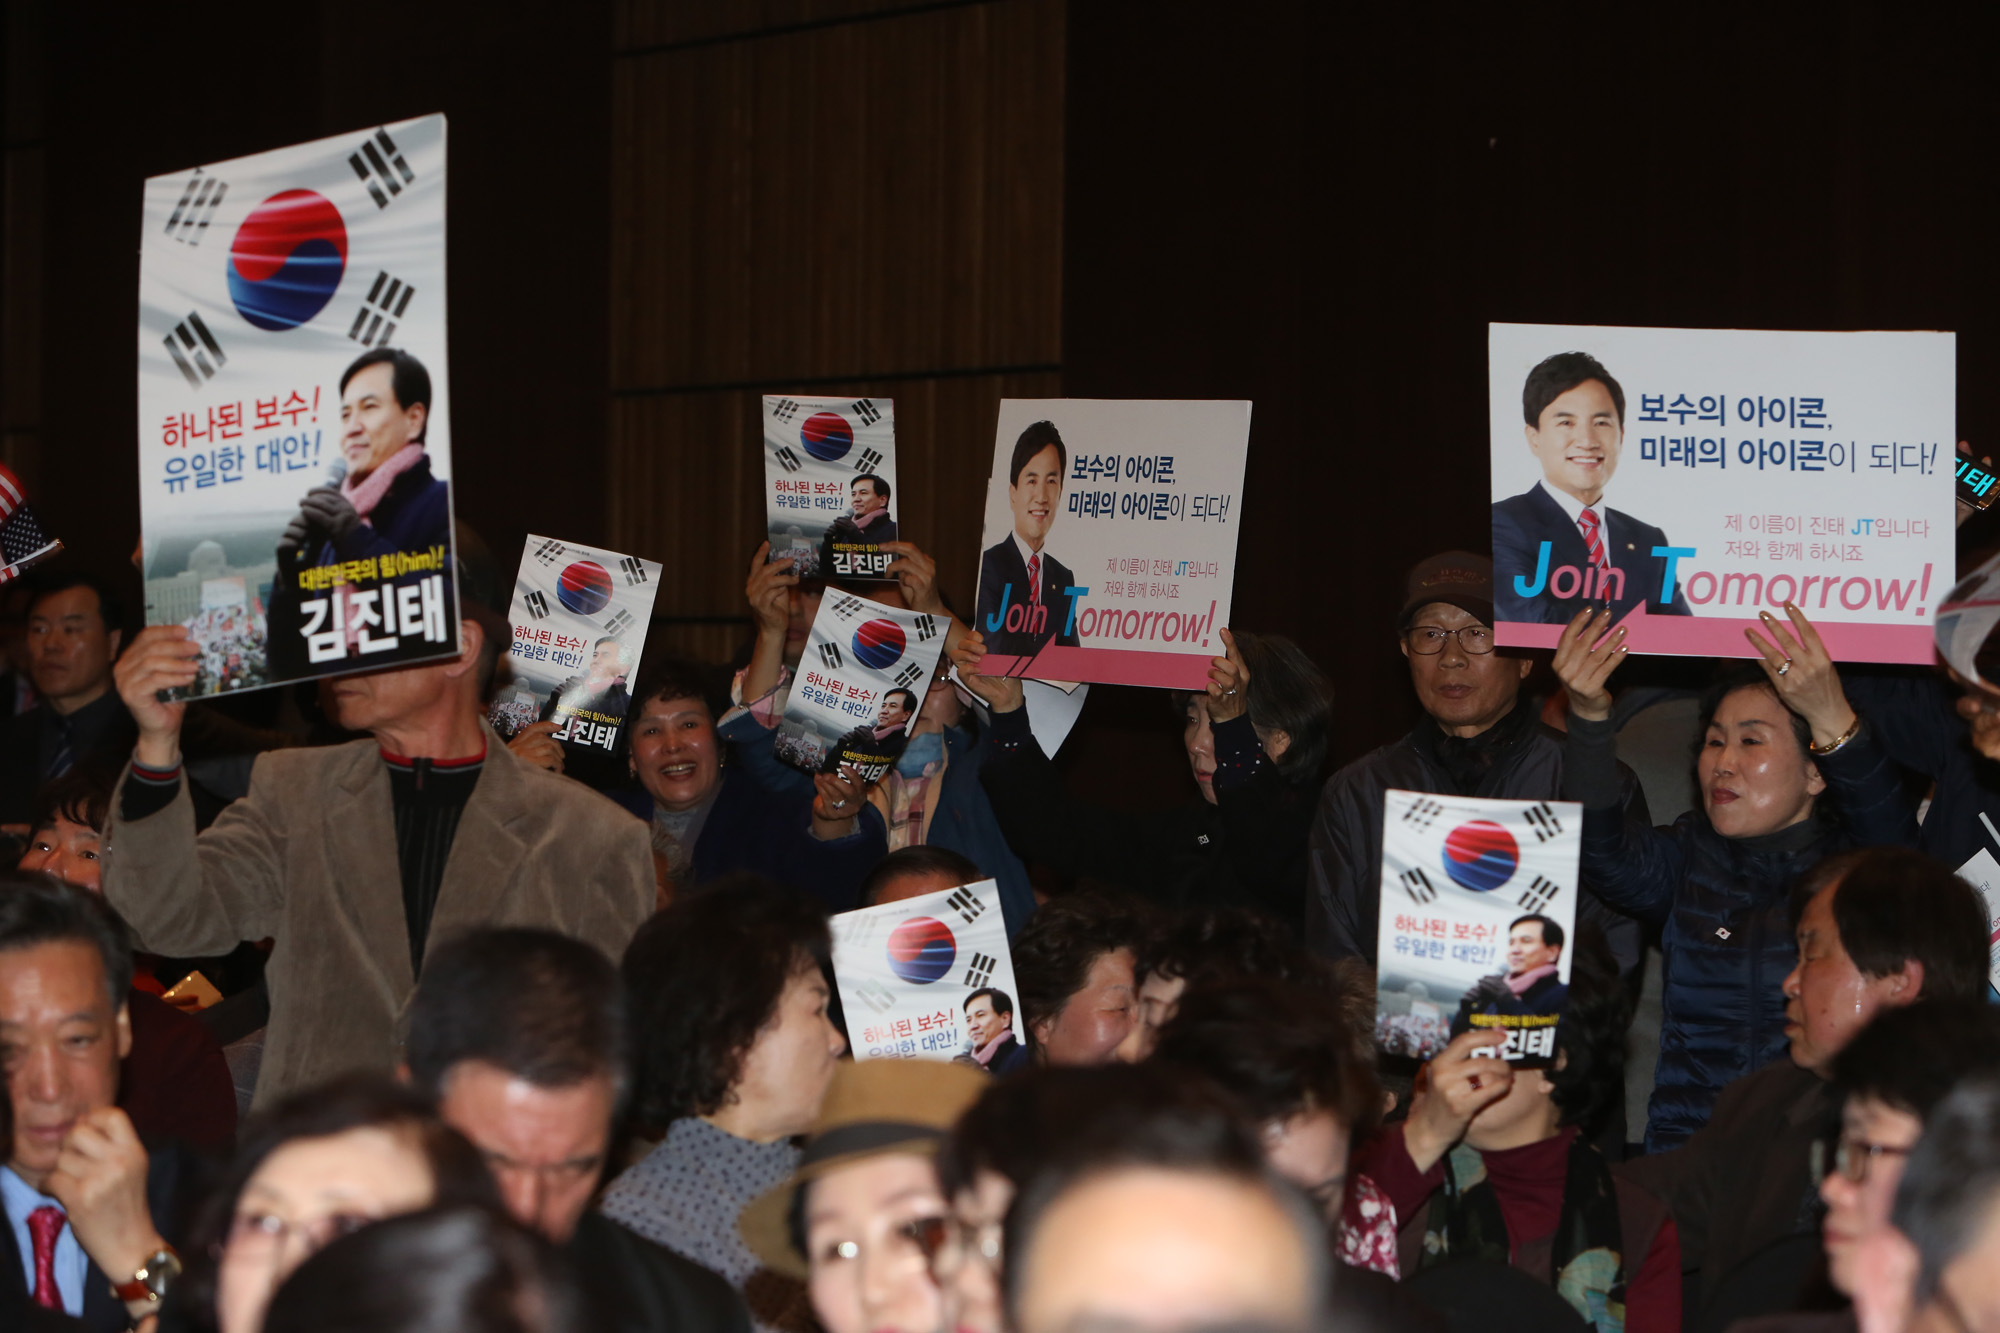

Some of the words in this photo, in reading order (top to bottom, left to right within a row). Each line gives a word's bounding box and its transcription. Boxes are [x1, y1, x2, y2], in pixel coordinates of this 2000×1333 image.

[162, 401, 243, 448] 하나된
[253, 385, 321, 431] 보수!
[1638, 393, 1727, 428] 보수의
[1737, 396, 1834, 431] 아이콘,
[163, 445, 246, 494] 유일한
[256, 429, 322, 474] 대안!
[1071, 454, 1121, 483] 보수의
[1125, 455, 1176, 485] 아이콘,
[1640, 435, 1727, 469] 미래의
[1738, 438, 1857, 473] 아이콘이
[1868, 441, 1938, 476] 되다!
[775, 480, 810, 494] 하나된
[813, 482, 843, 495] 보수!
[776, 494, 811, 509] 유일한
[815, 497, 844, 510] 대안!
[1068, 491, 1117, 519] 미래의
[1120, 492, 1186, 522] 아이콘이
[1191, 493, 1231, 523] 되다!
[1724, 514, 1743, 534] 제
[1749, 514, 1803, 536] 이름이
[1809, 516, 1846, 538] 진태
[1851, 518, 1930, 539] JT입니다
[1724, 539, 1762, 560] 저와
[1766, 541, 1805, 562] 함께
[1809, 541, 1865, 564] 하시죠
[299, 557, 378, 591] 대한민국의
[379, 545, 445, 578] 힘(him)!
[1106, 557, 1118, 573] 제
[1120, 558, 1149, 574] 이름이
[1152, 559, 1172, 576] 진태
[1174, 560, 1219, 579] JT입니다
[1512, 540, 1626, 601] Join
[1650, 545, 1934, 618] Tomorrow!
[1104, 580, 1124, 597] 저와
[1127, 580, 1148, 599] 함께
[1149, 582, 1180, 600] 하시죠
[299, 574, 447, 664] 김진태
[986, 583, 1048, 634] Join
[1063, 585, 1217, 648] Tomorrow!
[515, 625, 552, 646] 하나된
[554, 633, 588, 653] 보수!
[511, 641, 548, 662] 유일한
[552, 650, 583, 669] 대안!
[801, 685, 839, 710] 유일한
[841, 700, 873, 719] 대안!
[806, 671, 844, 695] 하나된
[845, 685, 878, 705] 보수!
[1394, 914, 1447, 939] 하나된
[1452, 921, 1497, 943] 보수!
[1394, 935, 1446, 961] 유일한
[1452, 942, 1496, 965] 대안!
[863, 1018, 913, 1044] 하나된
[917, 1008, 954, 1032] 보수!
[921, 1028, 958, 1051] 대안!
